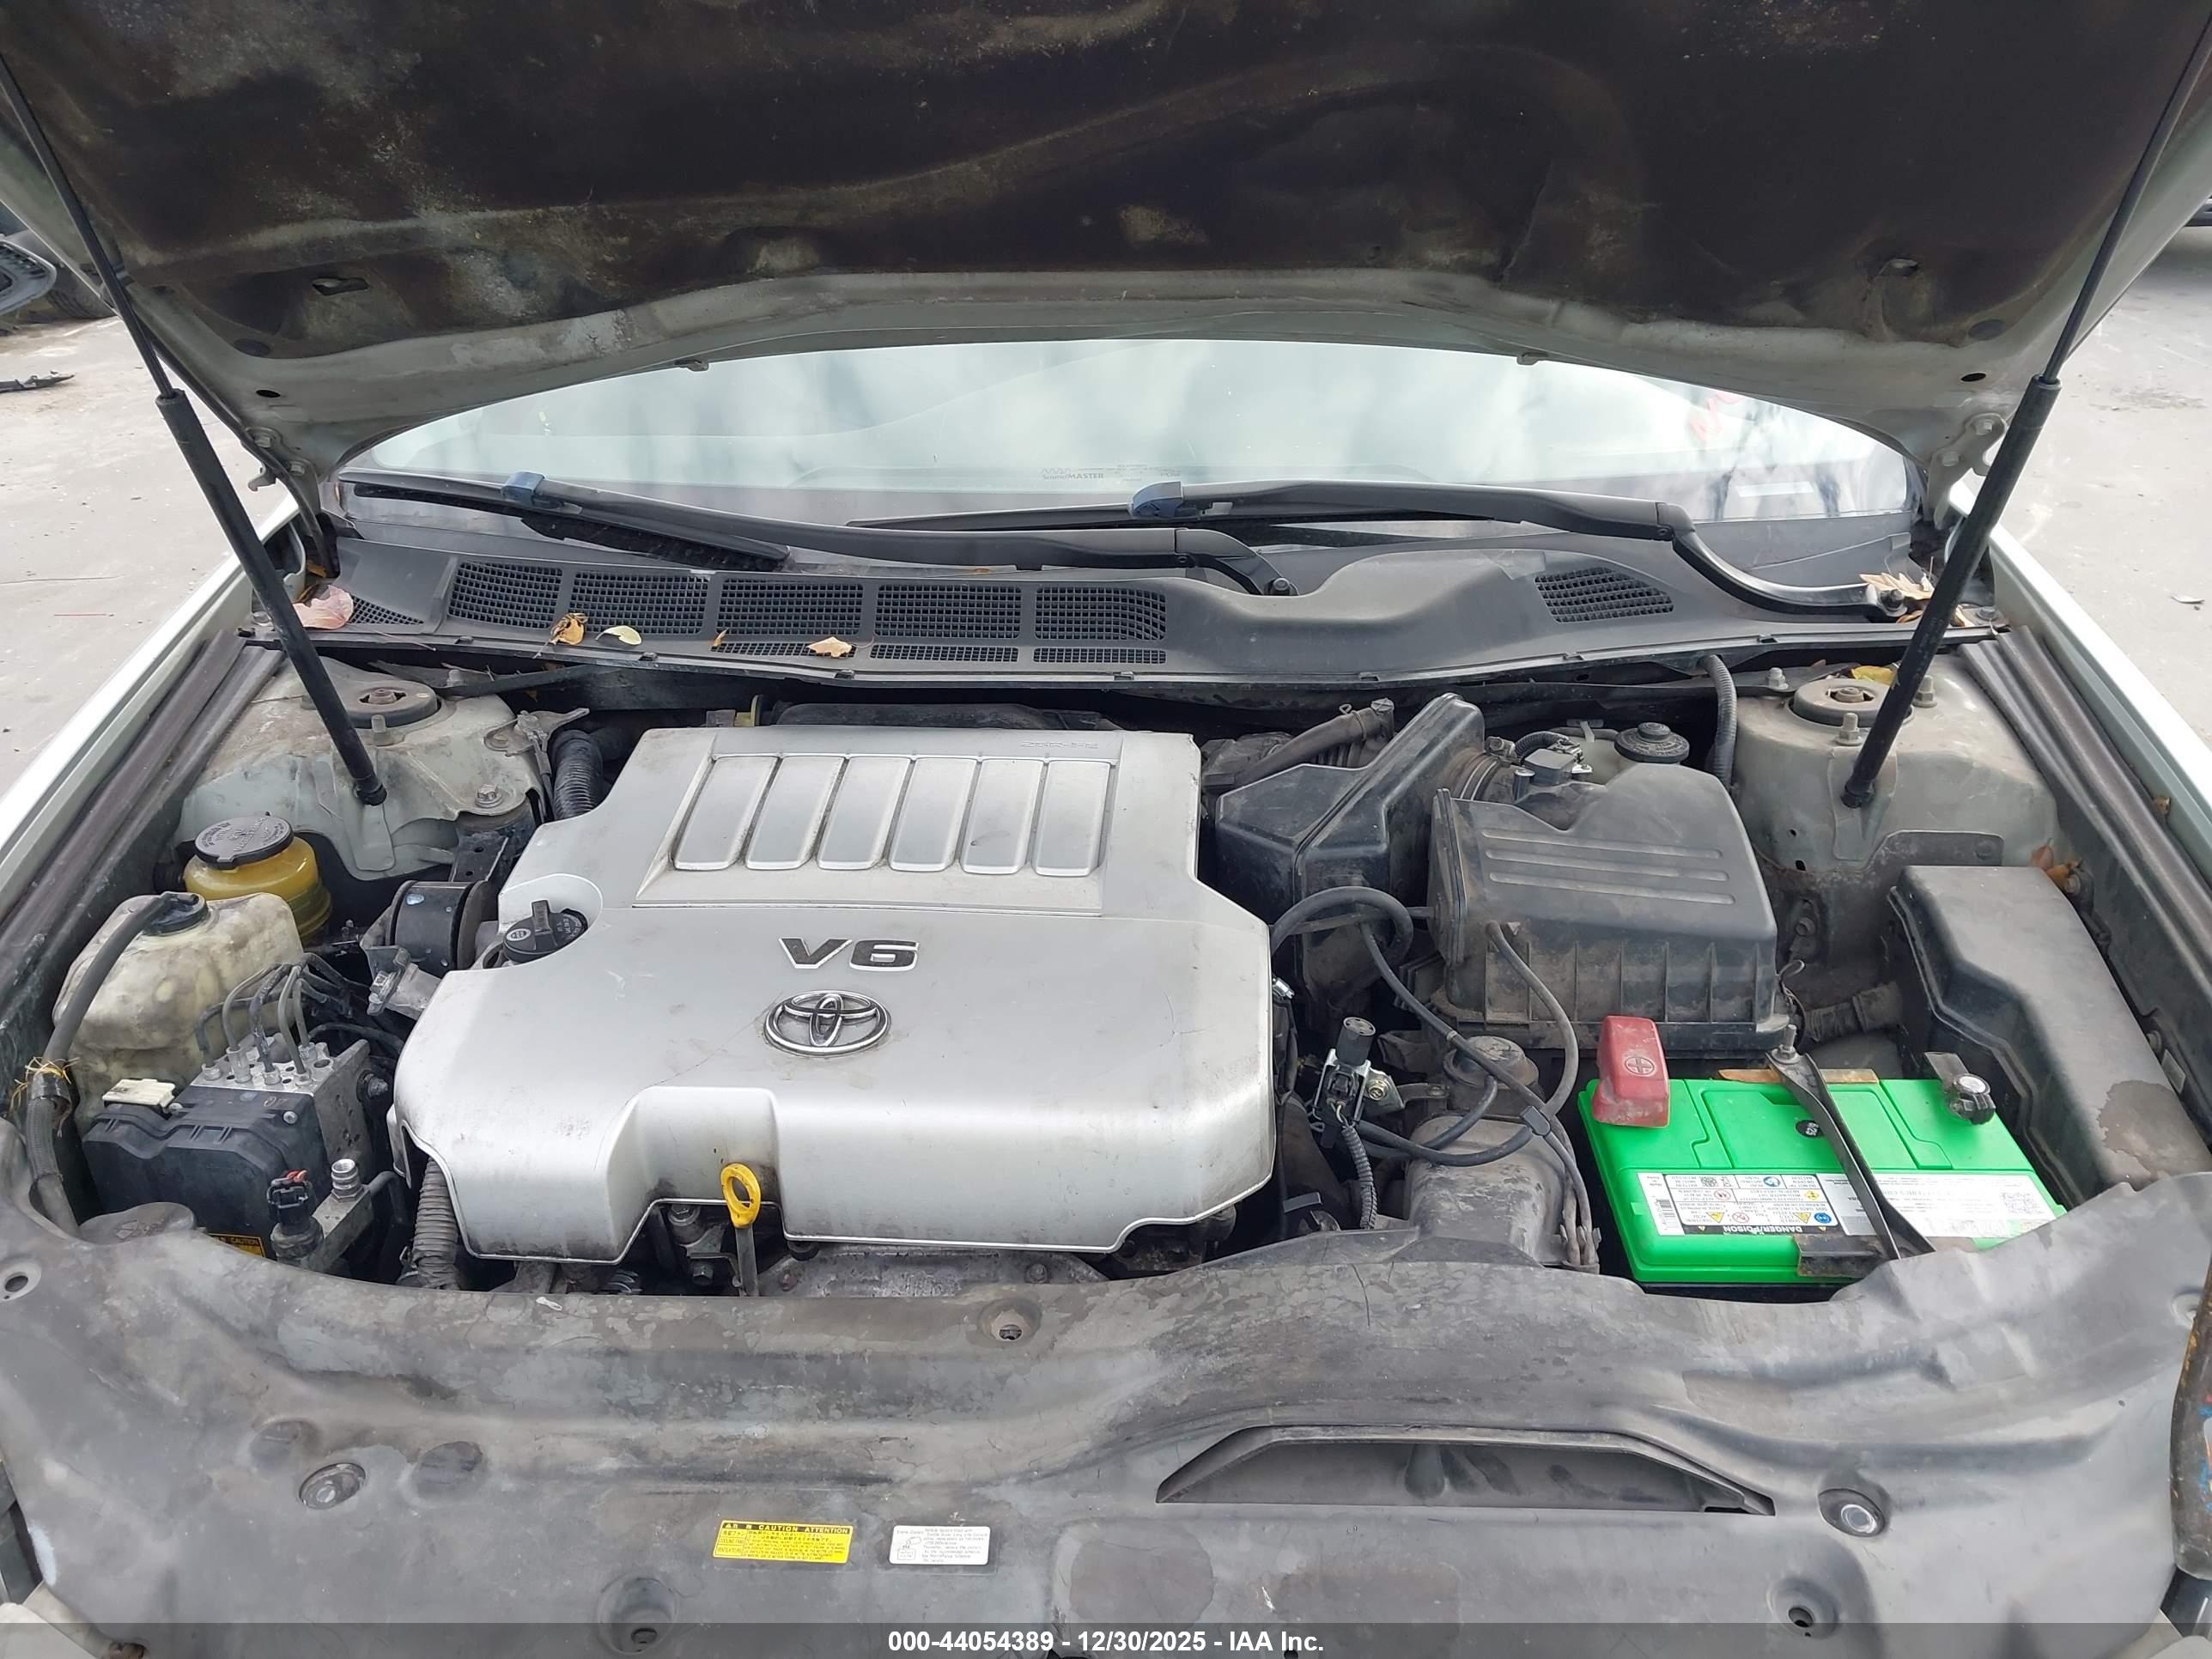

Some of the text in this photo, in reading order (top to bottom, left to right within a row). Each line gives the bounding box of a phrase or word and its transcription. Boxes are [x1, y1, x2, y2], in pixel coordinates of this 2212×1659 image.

[778, 937, 920, 972] V6
[1723, 1225, 1802, 1234] DANGER/POISON
[758, 1524, 798, 1533] CAUTION
[804, 1526, 848, 1534] ATTENTION
